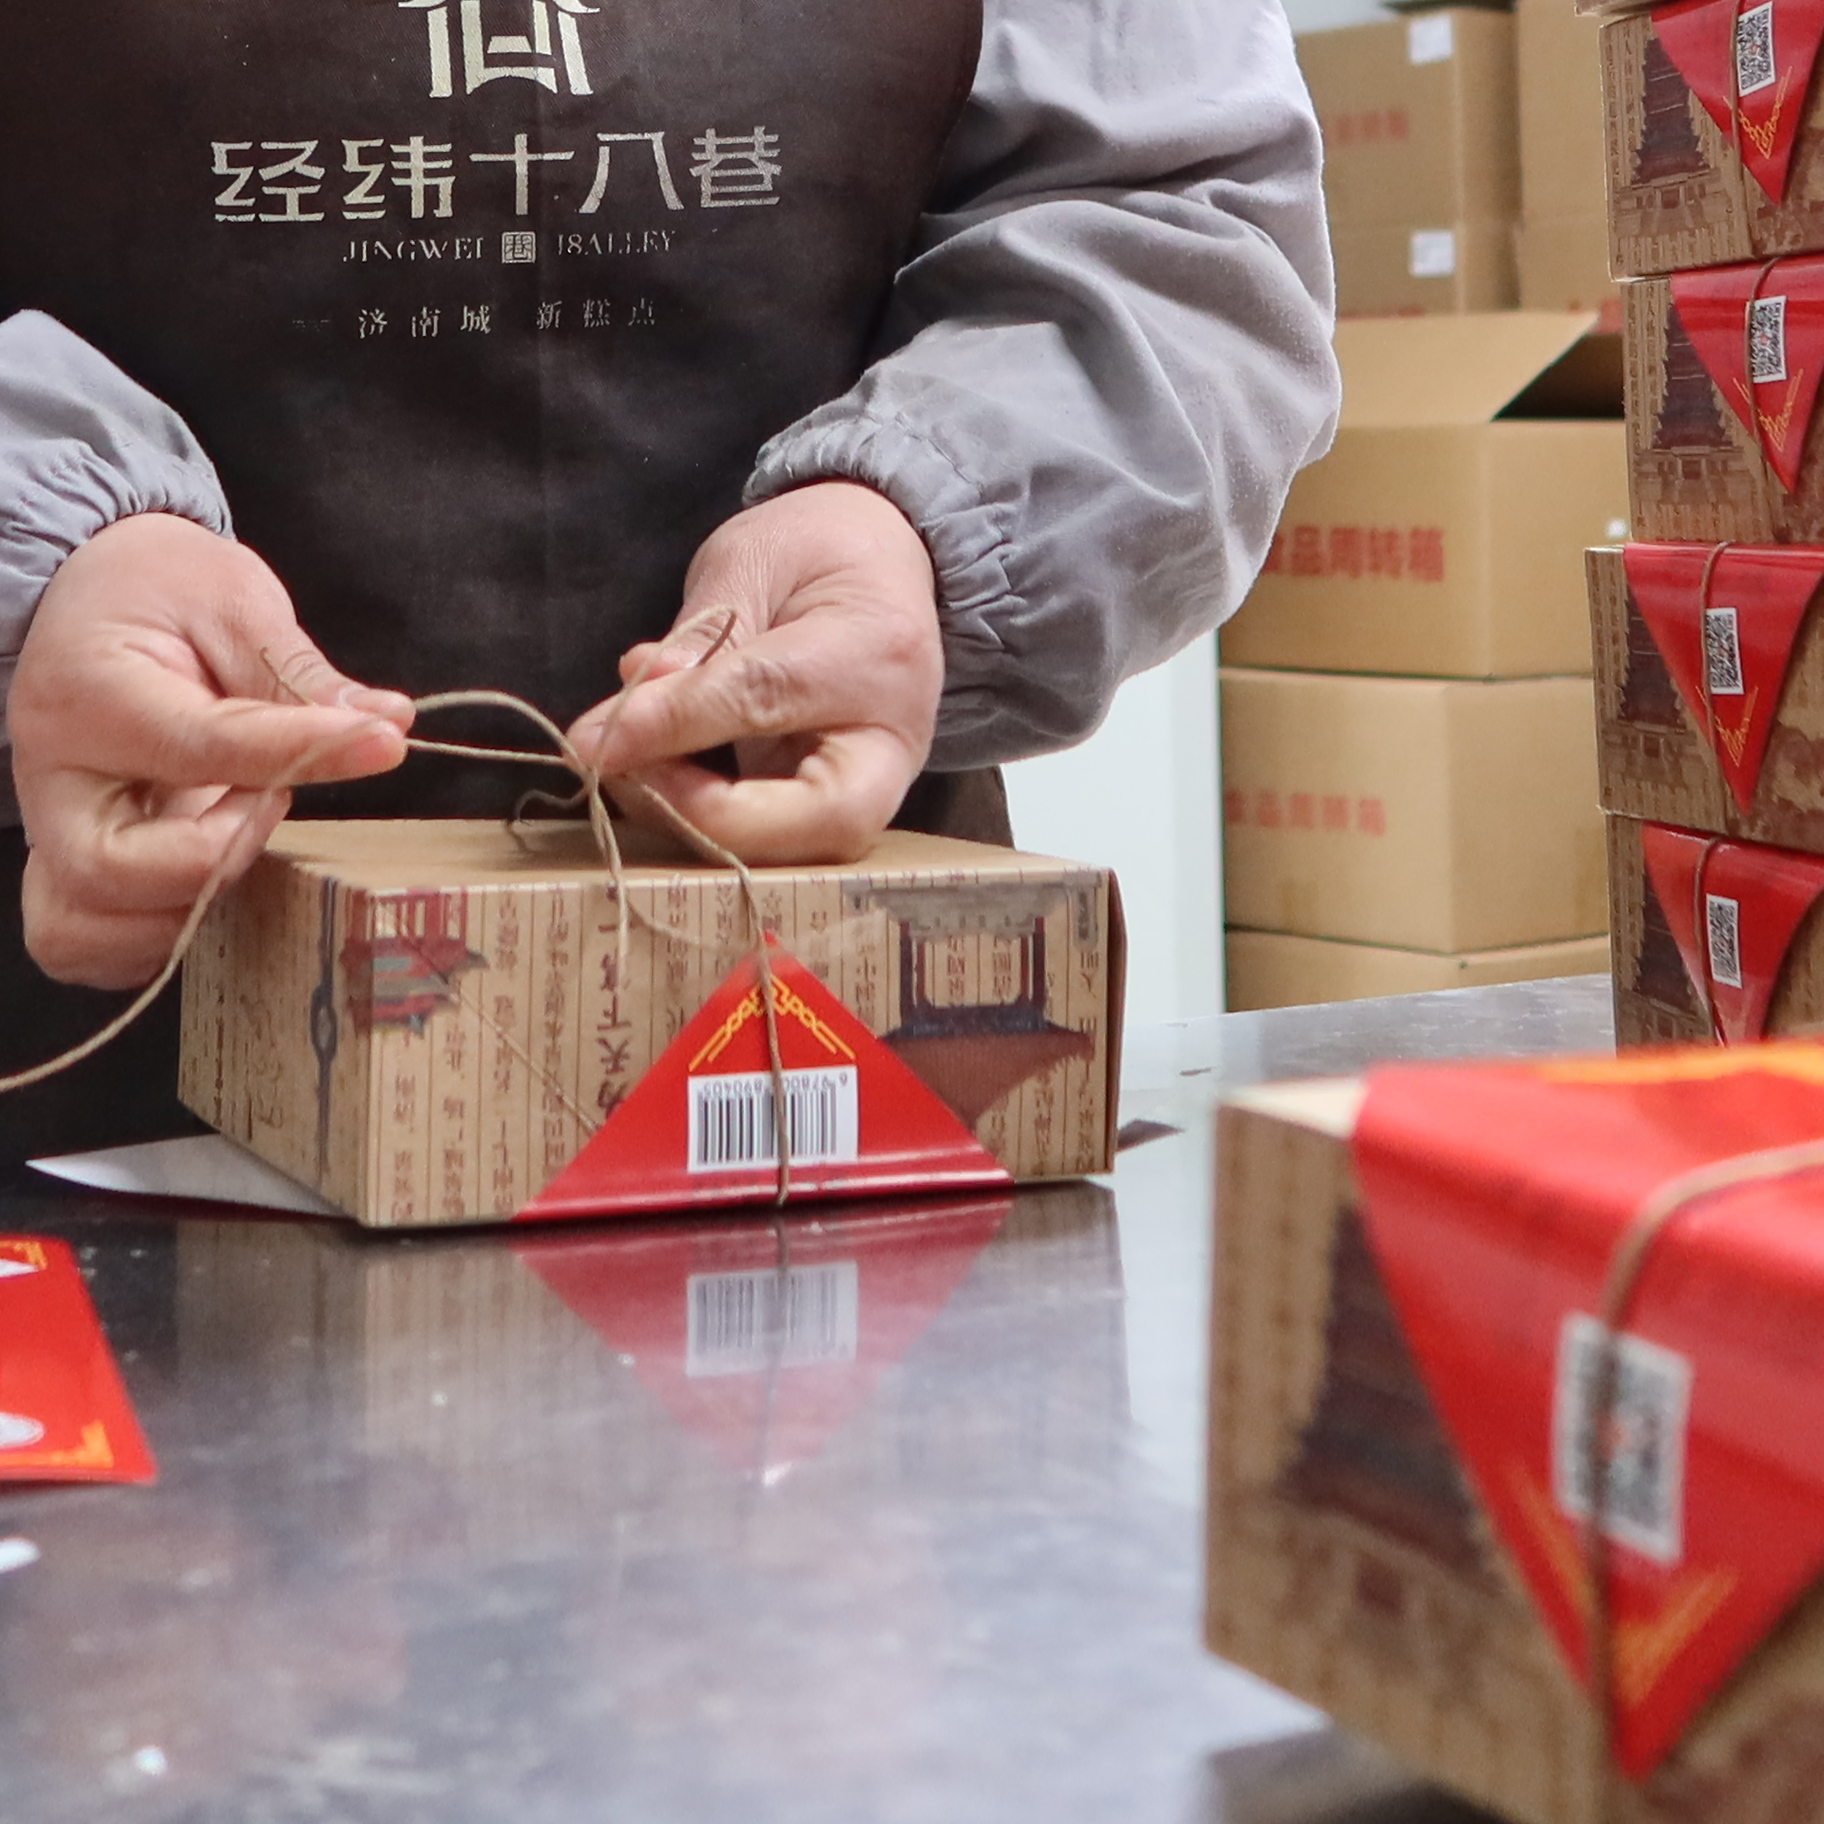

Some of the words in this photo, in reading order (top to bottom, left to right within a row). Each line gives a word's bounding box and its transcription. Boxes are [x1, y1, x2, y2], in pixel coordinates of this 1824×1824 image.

[209, 125, 783, 223] 经纬十八巷
[342, 236, 485, 263] JINGWEI
[357, 305, 492, 340] 济南城
[597, 882, 633, 1120] 为天下第一
